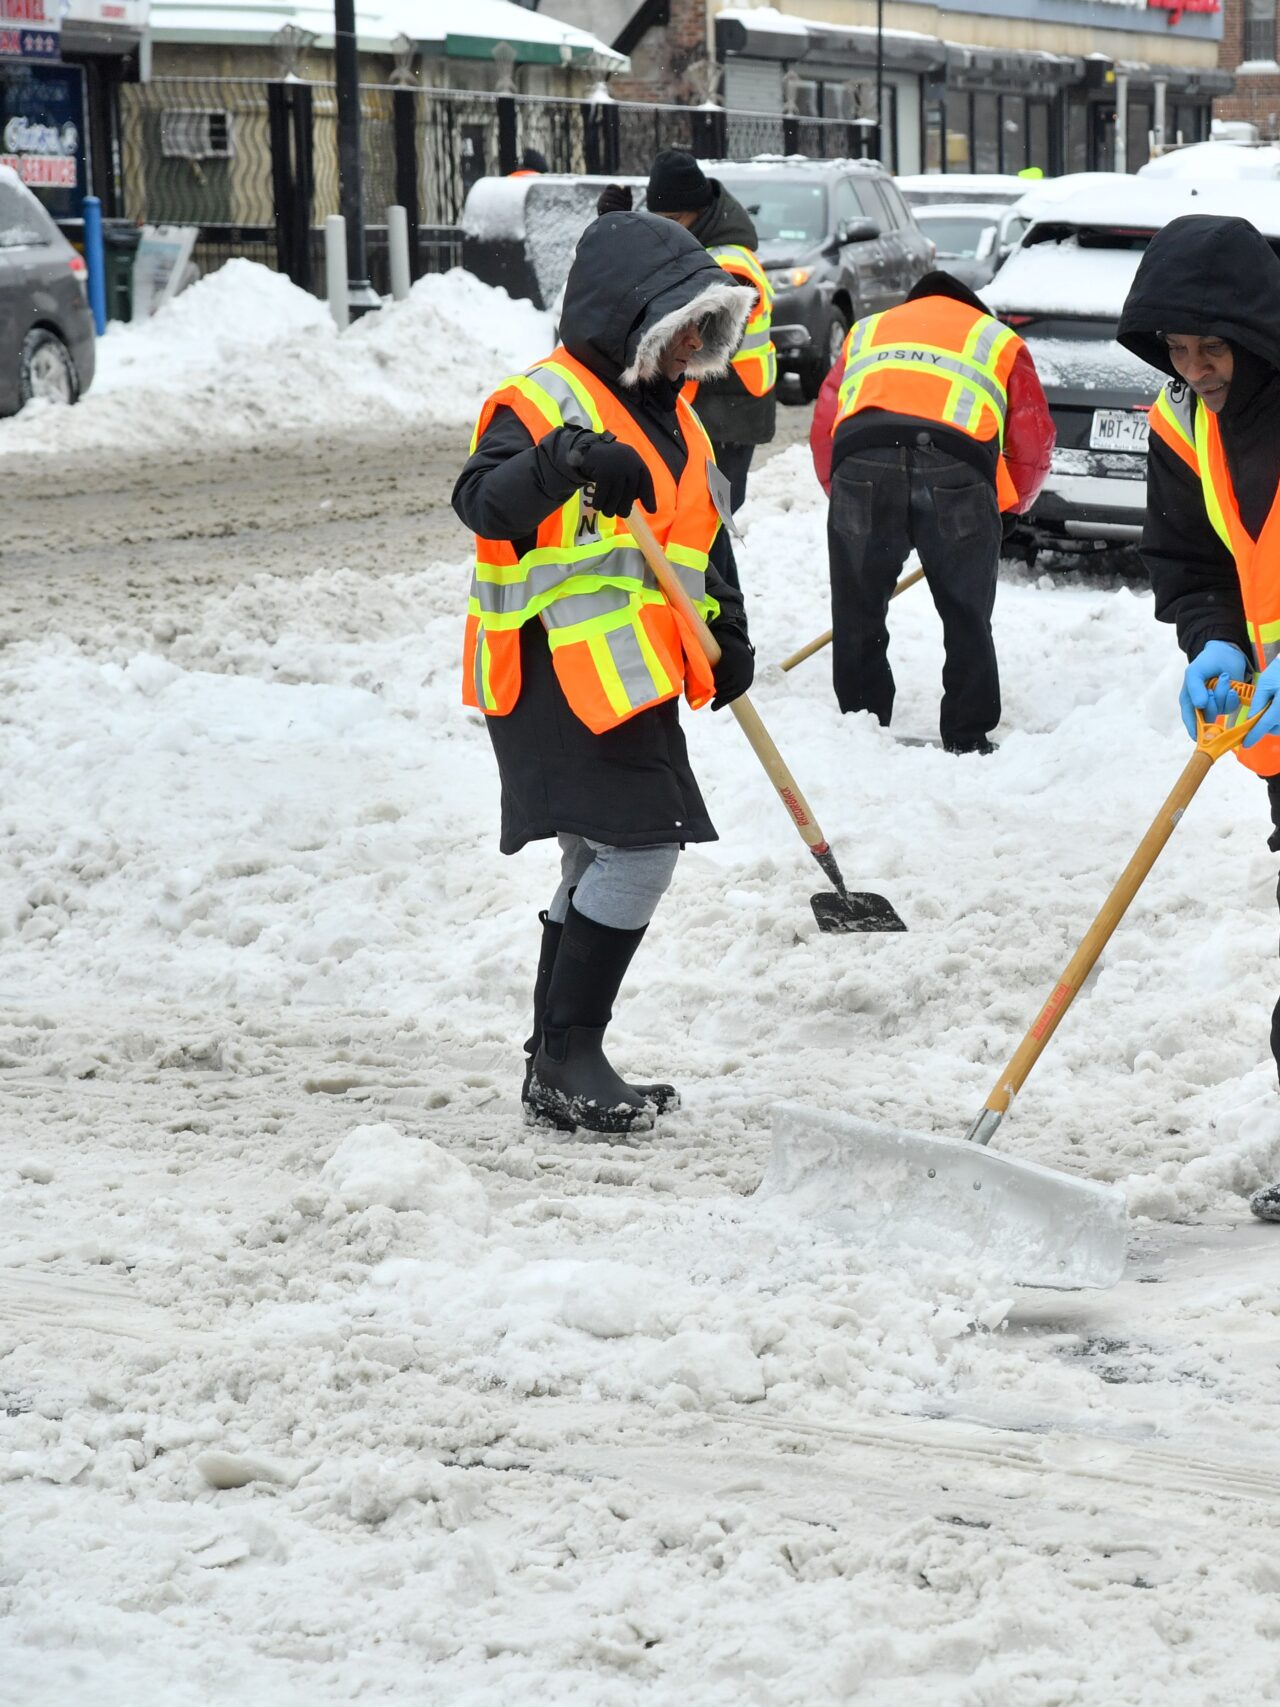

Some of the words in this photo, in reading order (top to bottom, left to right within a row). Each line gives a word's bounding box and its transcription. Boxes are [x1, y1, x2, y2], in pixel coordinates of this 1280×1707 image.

[877, 350, 942, 364] DSNY
[1099, 419, 1122, 438] MBT
[1132, 421, 1147, 441] 72
